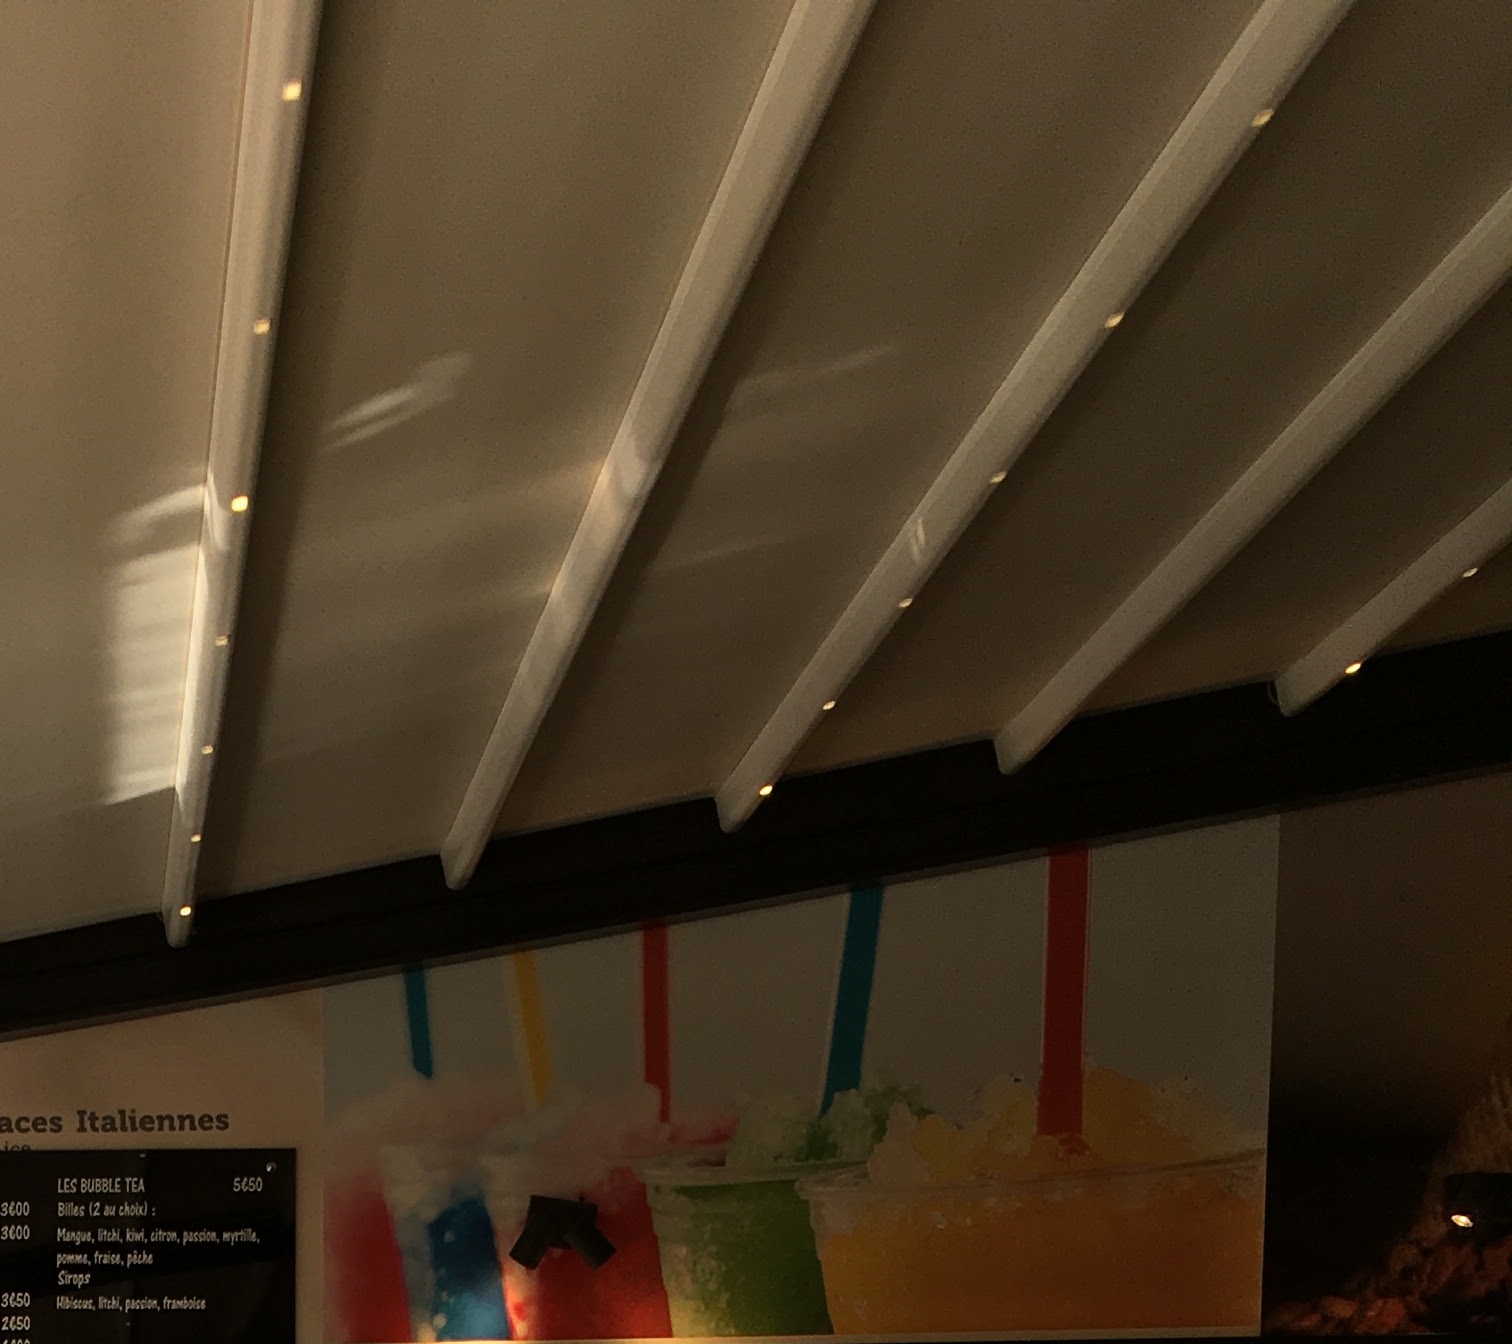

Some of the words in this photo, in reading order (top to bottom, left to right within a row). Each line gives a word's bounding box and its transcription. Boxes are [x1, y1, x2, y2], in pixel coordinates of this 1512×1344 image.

[76, 1109, 230, 1132] Italiennes
[58, 1178, 77, 1193] LES
[81, 1178, 121, 1193] BUBBLE
[125, 1178, 145, 1192] TEA
[233, 1177, 263, 1191] 5€50
[0, 1201, 29, 1216] 3€00
[58, 1202, 84, 1216] Billes
[89, 1202, 100, 1216] (2
[104, 1205, 115, 1216] au
[119, 1202, 147, 1216] choix)
[1, 1225, 30, 1240] 3€00
[127, 1250, 153, 1268] pêche
[58, 1271, 90, 1288] Sirops
[1, 1293, 30, 1307] 3€50
[2, 1316, 30, 1331] 2€50
